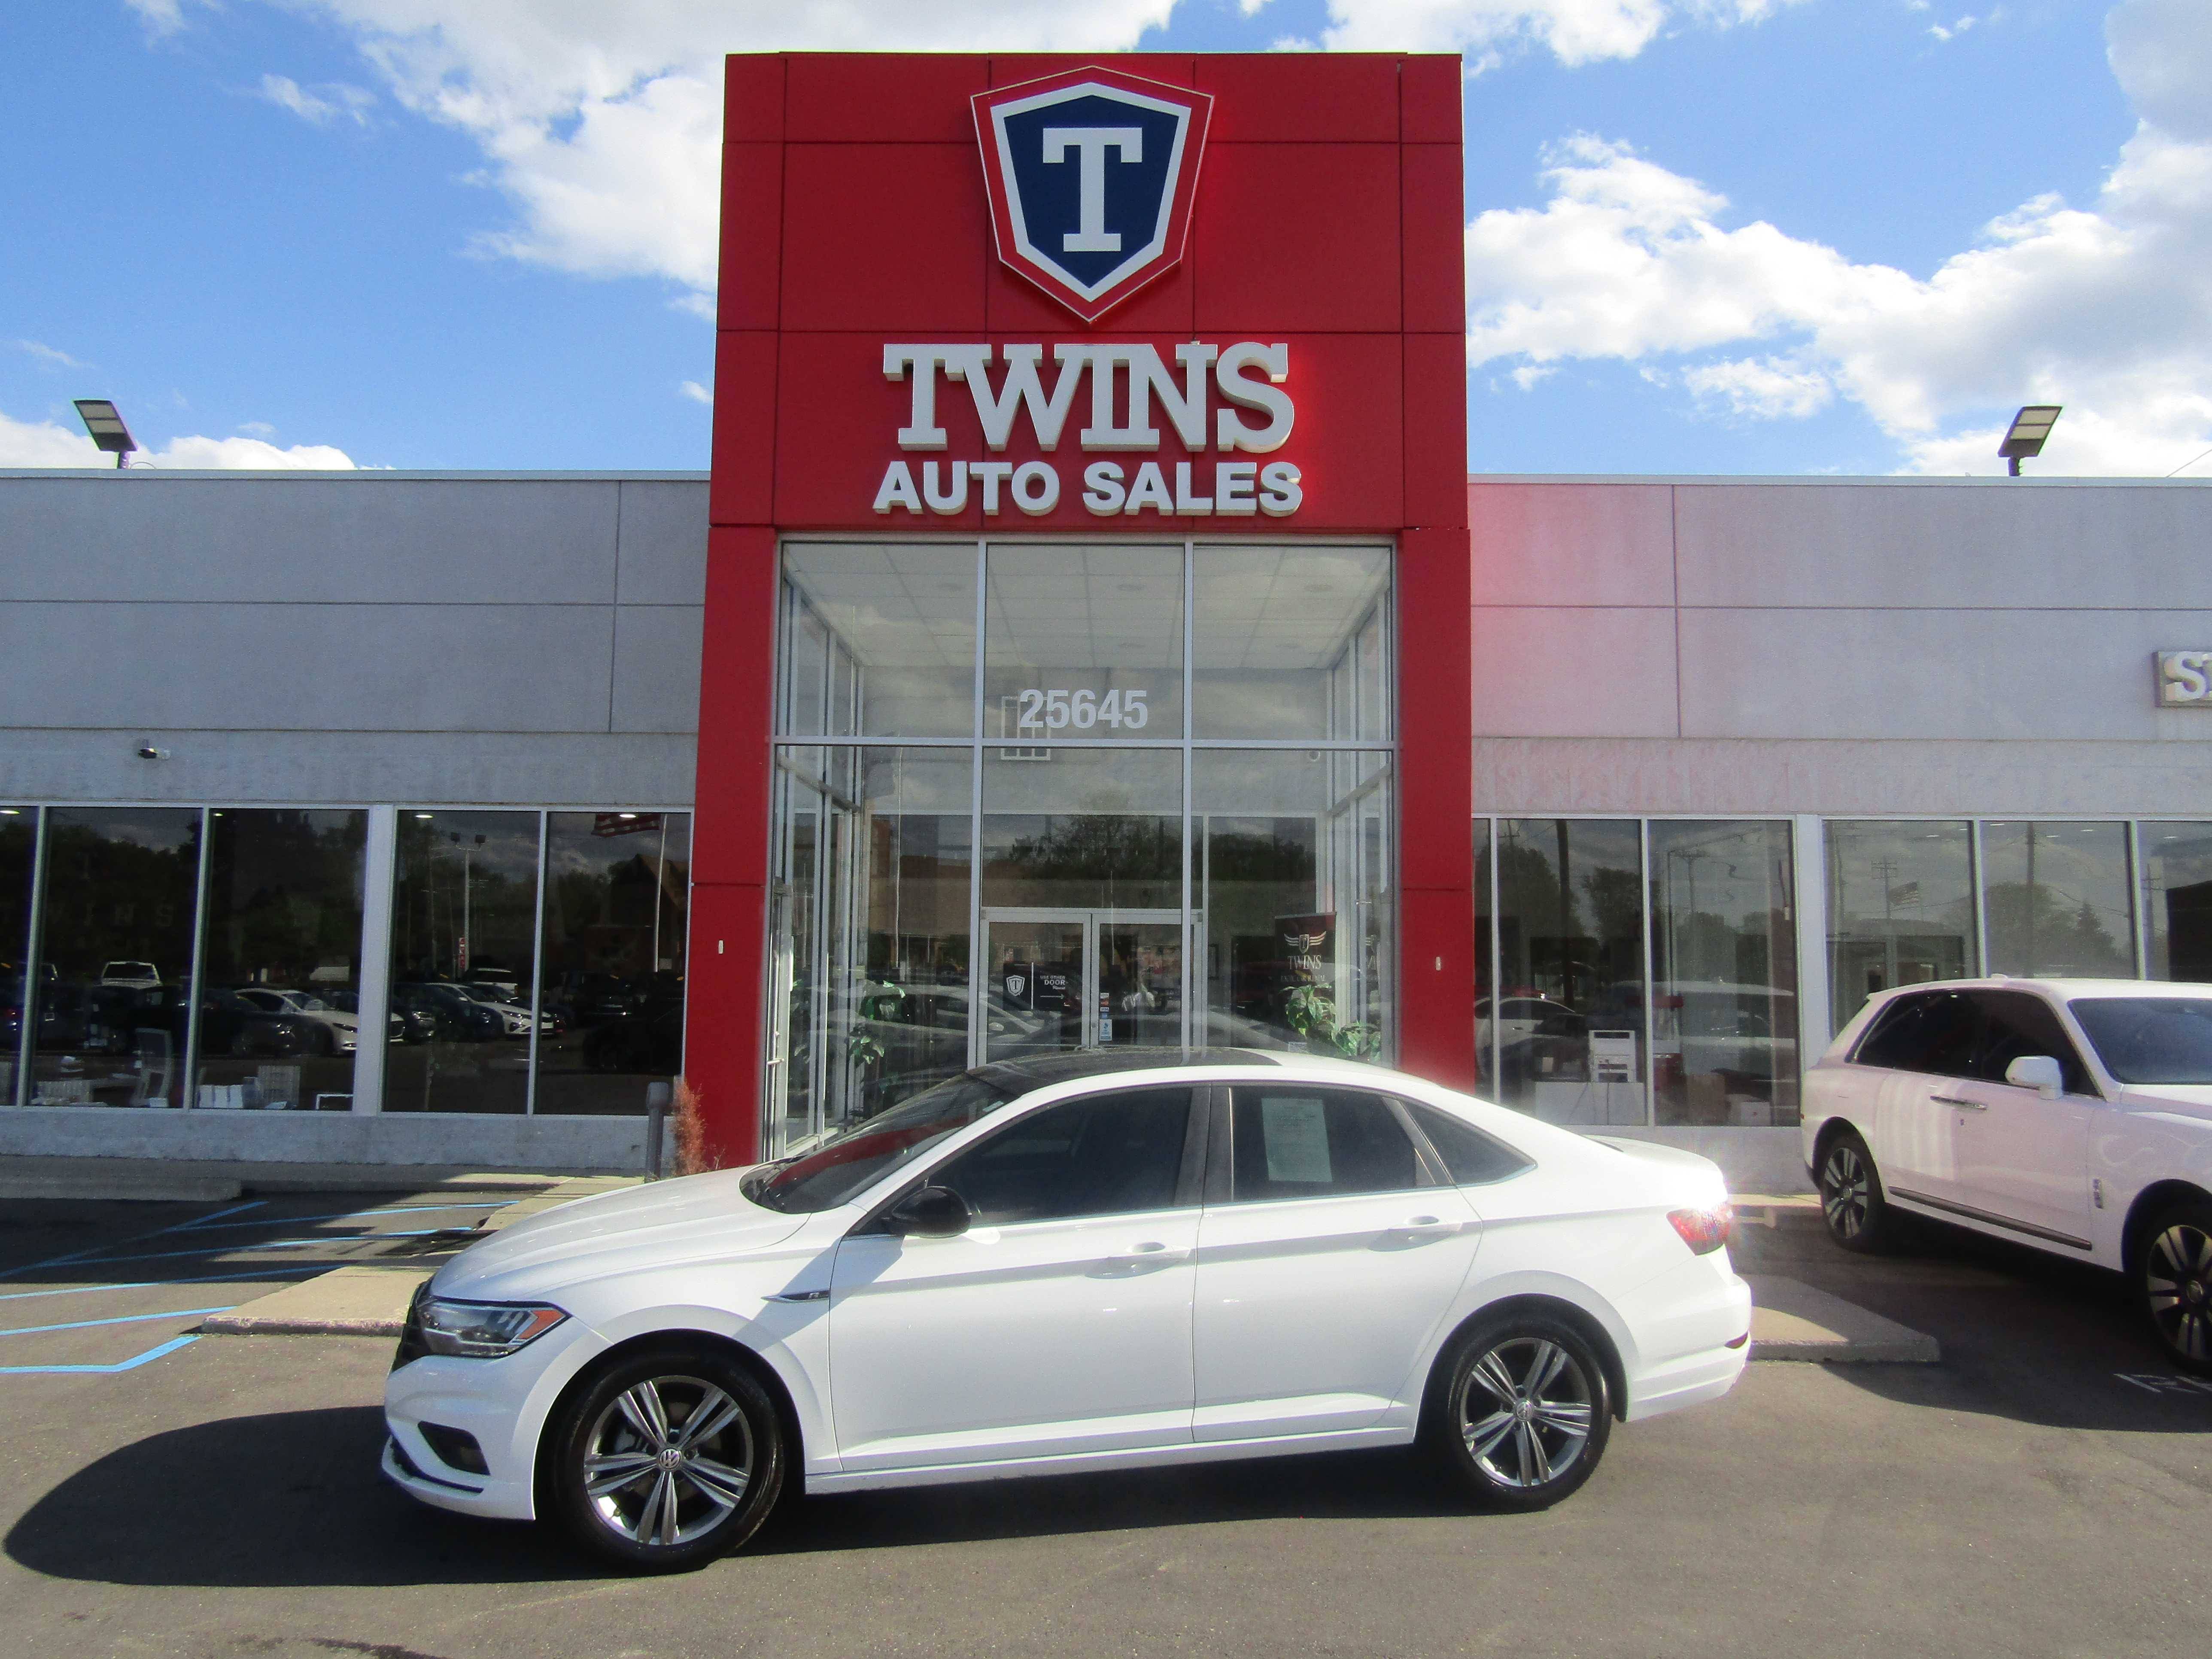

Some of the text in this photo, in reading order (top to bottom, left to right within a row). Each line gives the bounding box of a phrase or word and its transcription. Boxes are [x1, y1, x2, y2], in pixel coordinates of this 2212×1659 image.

[1043, 128, 1142, 251] T
[884, 341, 1294, 454] TWINS
[872, 460, 1303, 517] AUTO SALES
[2164, 651, 2212, 702] S
[1020, 689, 1148, 729] 25645
[1288, 954, 1322, 969] TWINS
